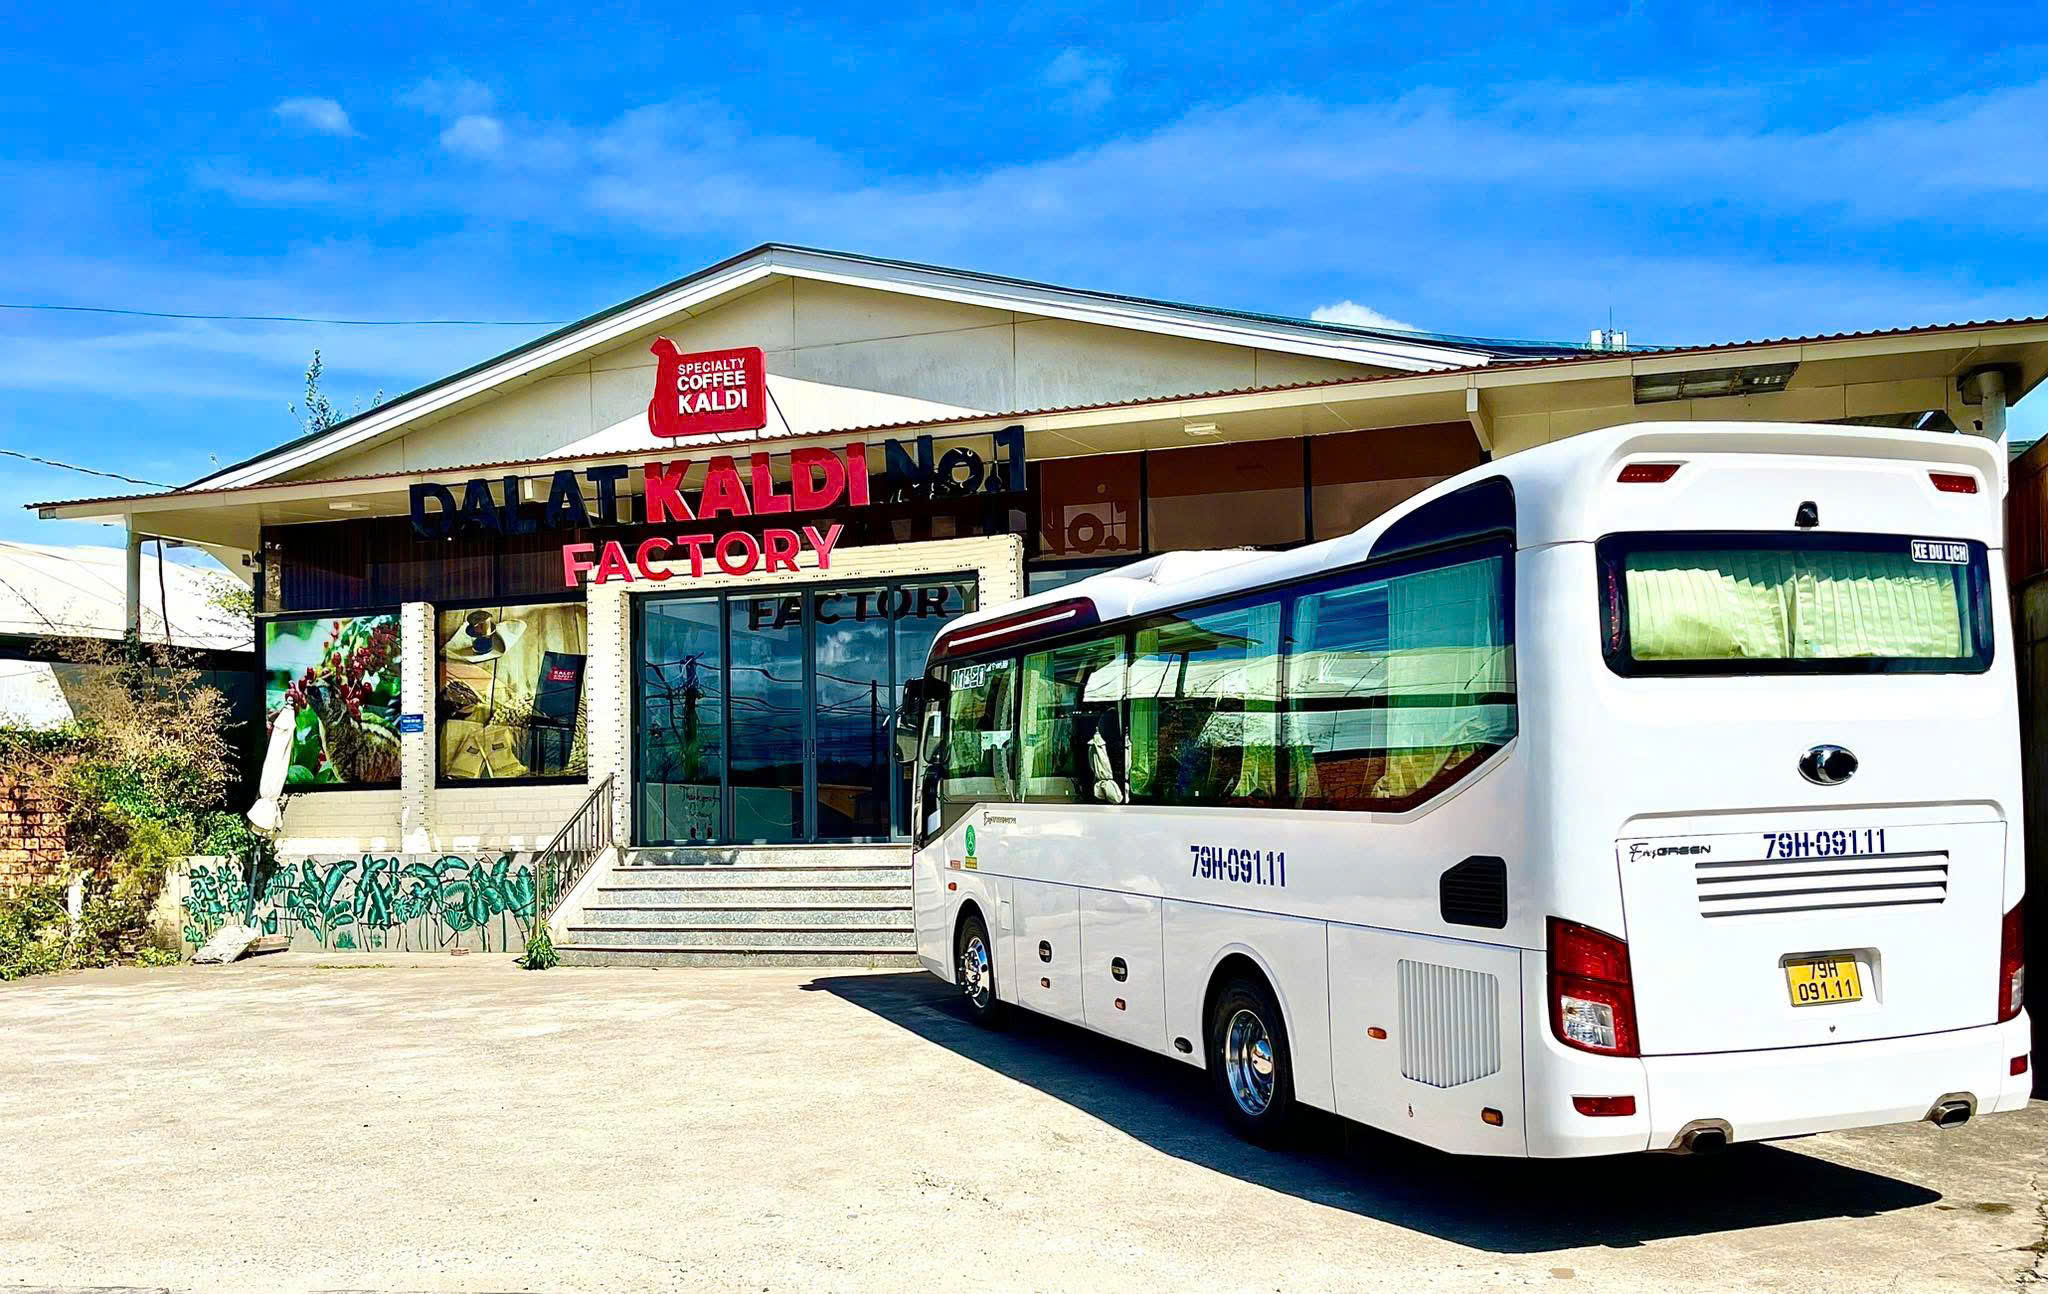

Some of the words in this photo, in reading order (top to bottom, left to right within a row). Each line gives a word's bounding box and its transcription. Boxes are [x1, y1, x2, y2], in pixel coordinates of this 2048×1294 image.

[678, 358, 745, 375] SPECIALTY
[677, 370, 747, 391] COFFEE
[678, 388, 749, 414] KALDI
[408, 464, 628, 540] DALAT
[644, 442, 870, 524] KALDI
[562, 523, 845, 588] FACTORY
[1913, 543, 1928, 559] XE
[1928, 544, 1943, 560] DU
[1808, 960, 1838, 980] 79H
[1798, 979, 1853, 1001] 091.11
